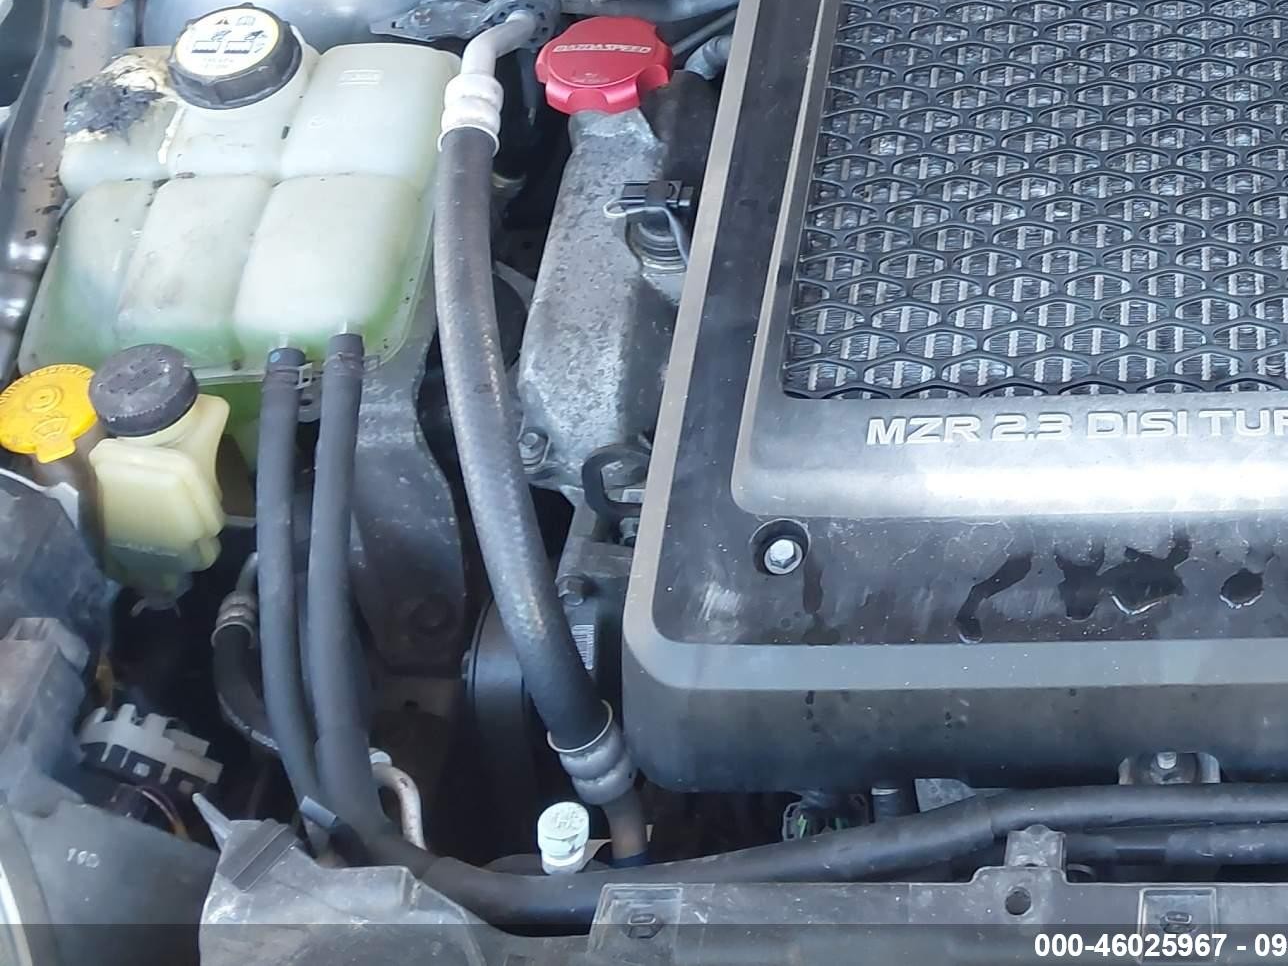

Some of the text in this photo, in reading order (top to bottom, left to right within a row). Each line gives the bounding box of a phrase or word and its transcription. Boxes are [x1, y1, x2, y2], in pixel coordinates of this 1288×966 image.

[867, 416, 981, 445] MZR
[991, 413, 1073, 442] 2.3
[1087, 410, 1188, 440] DISI
